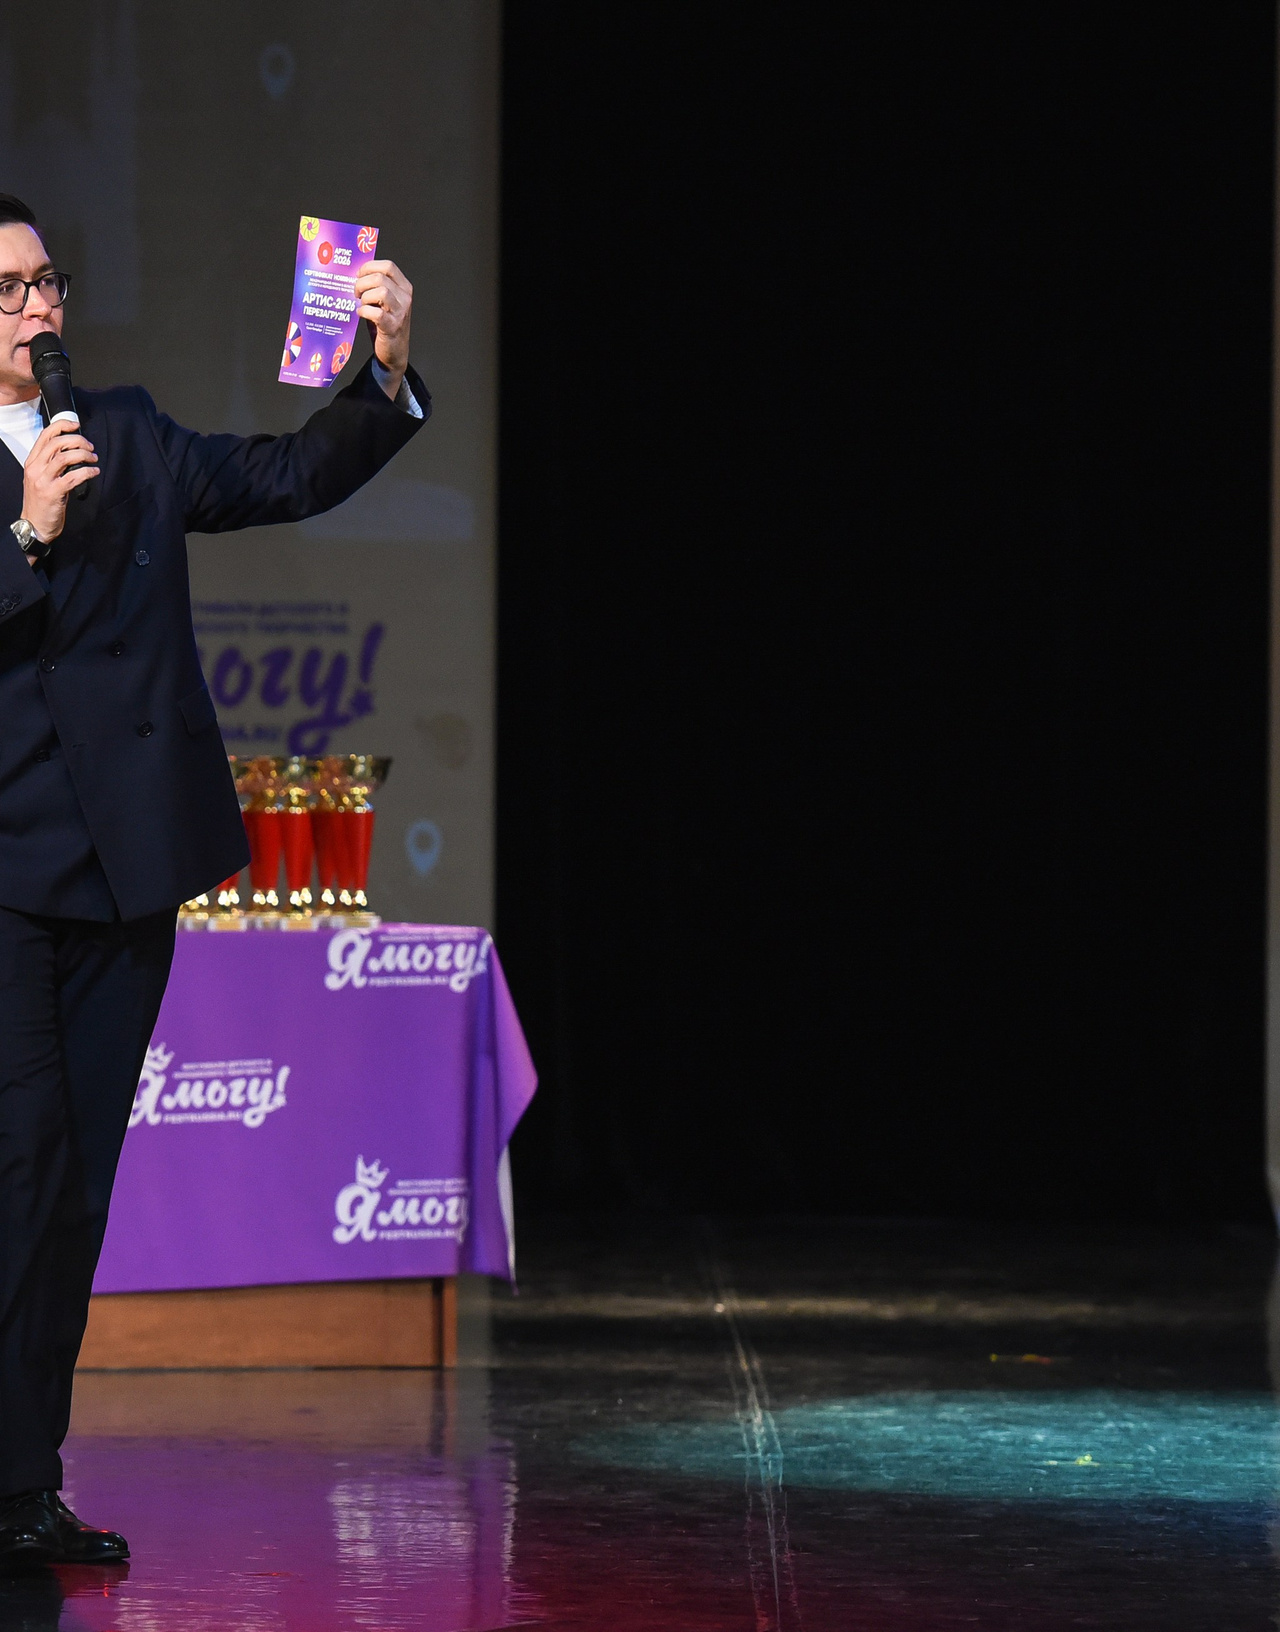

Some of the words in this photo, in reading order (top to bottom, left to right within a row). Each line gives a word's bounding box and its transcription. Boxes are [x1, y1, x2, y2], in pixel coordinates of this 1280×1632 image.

[333, 255, 351, 266] 2026
[335, 247, 353, 257] АРТИС
[302, 291, 356, 312] АРТИС-2026
[303, 306, 351, 323] ПЕРЕЗАГРУЗКА
[324, 929, 373, 991] Я
[367, 934, 493, 993] могу!
[161, 1065, 291, 1128] могу!
[332, 1183, 382, 1244] Я
